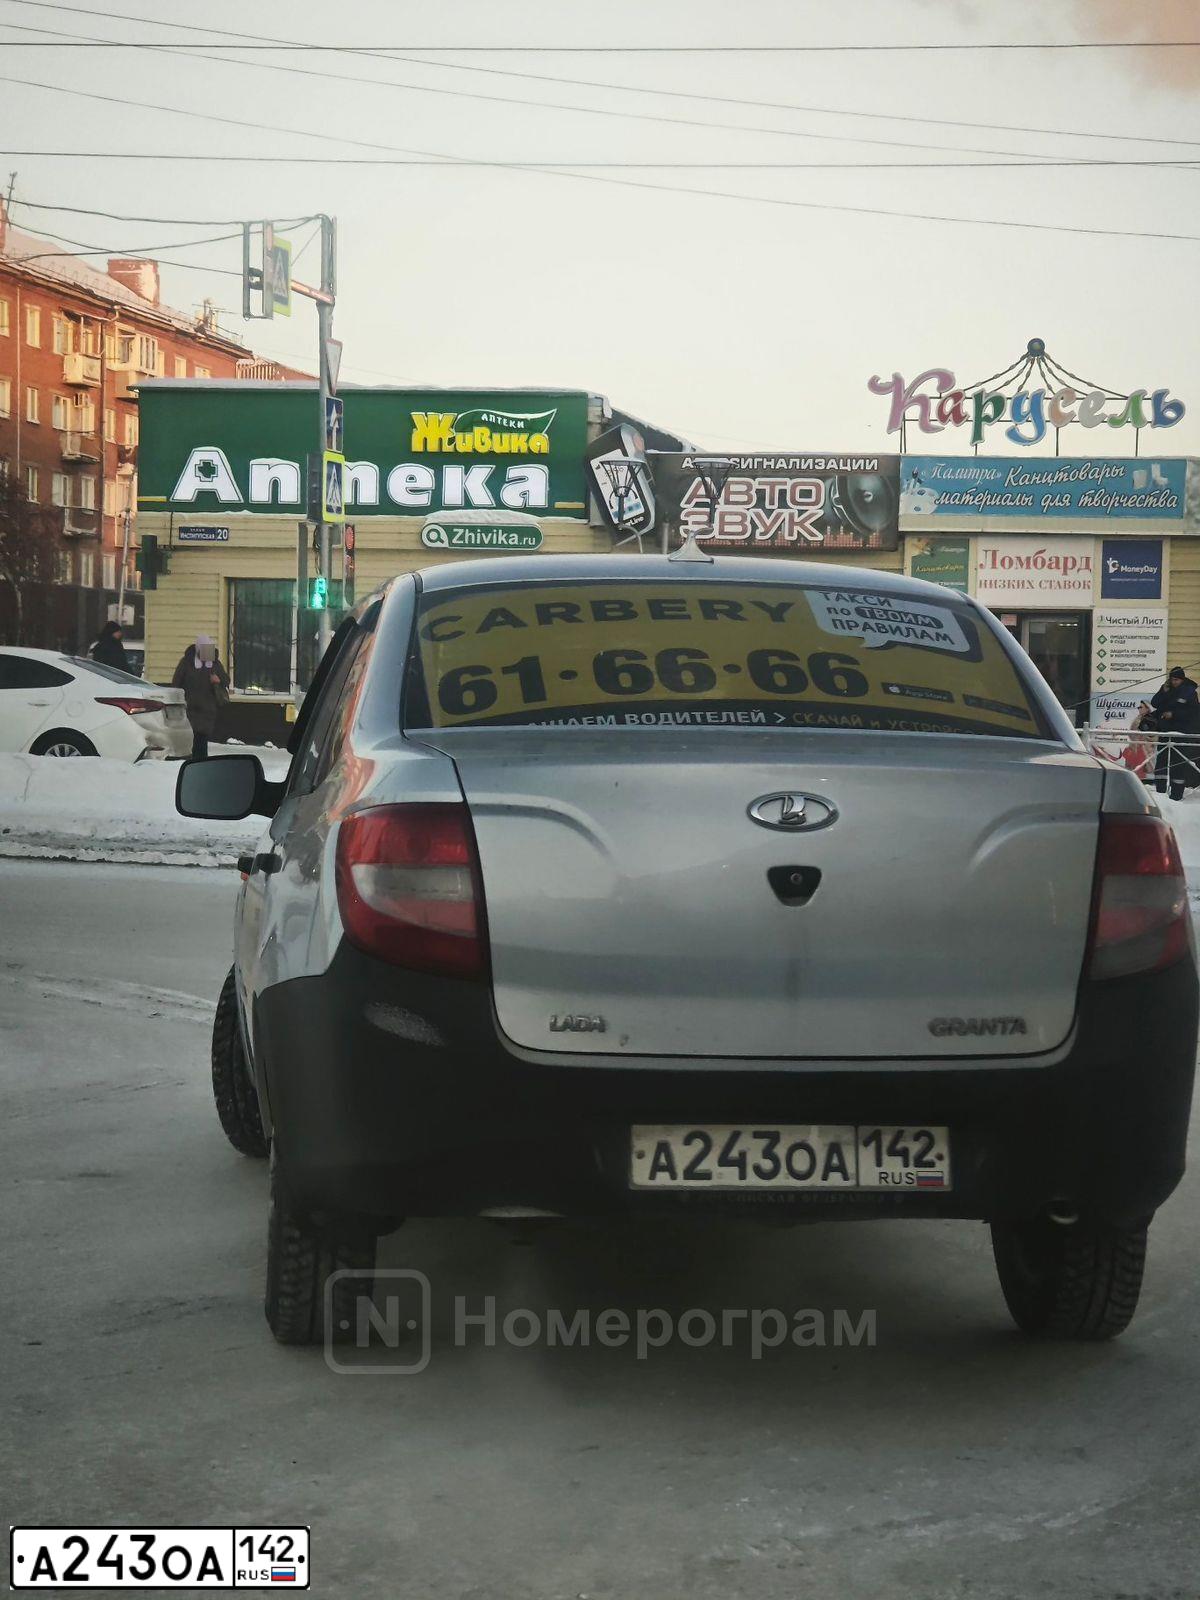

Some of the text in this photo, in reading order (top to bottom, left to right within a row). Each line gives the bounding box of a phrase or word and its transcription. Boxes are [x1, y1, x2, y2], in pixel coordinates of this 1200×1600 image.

[867, 369, 1186, 446] Карусель
[481, 413, 525, 429] АПТЕКИ
[410, 412, 550, 454] Живика
[682, 457, 878, 472] АСИГНАЛИЗАЦИИ
[1004, 463, 1126, 487] Канцтовары
[680, 476, 825, 510] АВТО
[934, 488, 1178, 514] материалы для творчества
[680, 508, 825, 540] ЗВУК
[217, 528, 228, 540] 20
[451, 528, 536, 546] Zhivika.ru
[979, 549, 1092, 576] Ломбард
[1120, 565, 1158, 575] MoneyDay
[979, 579, 1035, 590] НИЗКИХ
[1039, 579, 1092, 590] СТАВОК
[818, 591, 893, 608] ТАКСИ
[420, 598, 795, 642] CARBERY
[826, 606, 938, 629] по ТВОИМ
[1106, 616, 1163, 625] Чистый Лист
[832, 618, 955, 645] ПРАВИЛАМ
[1096, 698, 1136, 710] Шубкин
[624, 709, 766, 726] ВОДИТЕЛЕЙ
[792, 711, 863, 726] СКАЧАЙ
[1104, 710, 1126, 721] дом
[549, 1014, 606, 1033] LADA
[927, 1017, 1028, 1036] GRANTA
[862, 1129, 936, 1168] 142
[878, 1171, 915, 1185] RUS
